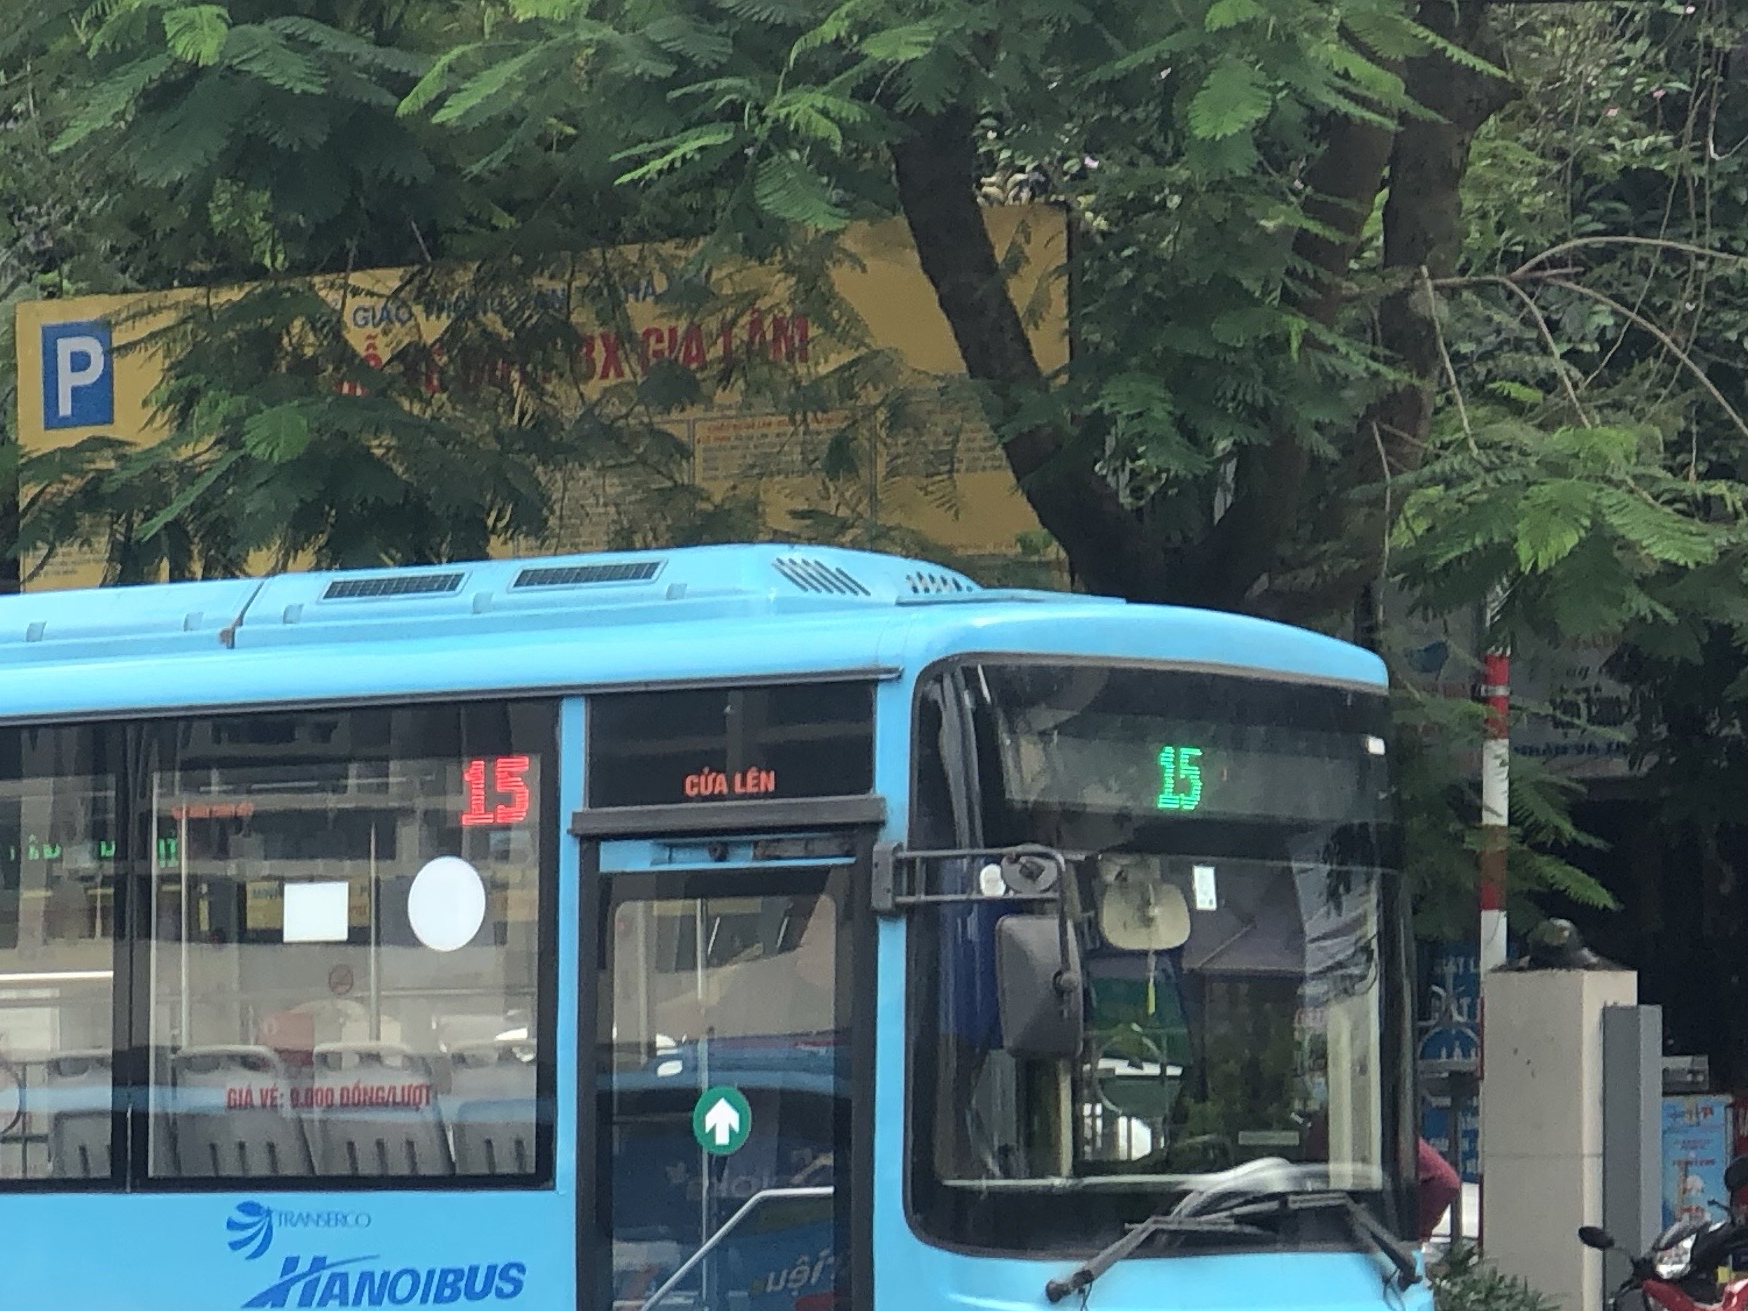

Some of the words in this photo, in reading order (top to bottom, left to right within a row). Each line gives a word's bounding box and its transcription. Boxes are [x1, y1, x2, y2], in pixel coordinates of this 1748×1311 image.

[56, 336, 105, 417] P
[460, 755, 530, 826] 15
[684, 766, 729, 798] CỬA
[734, 766, 776, 795] LÊN
[1157, 746, 1203, 811] 15
[277, 1210, 372, 1229] TRANSERCO
[240, 1254, 527, 1309] HANOIBUS
